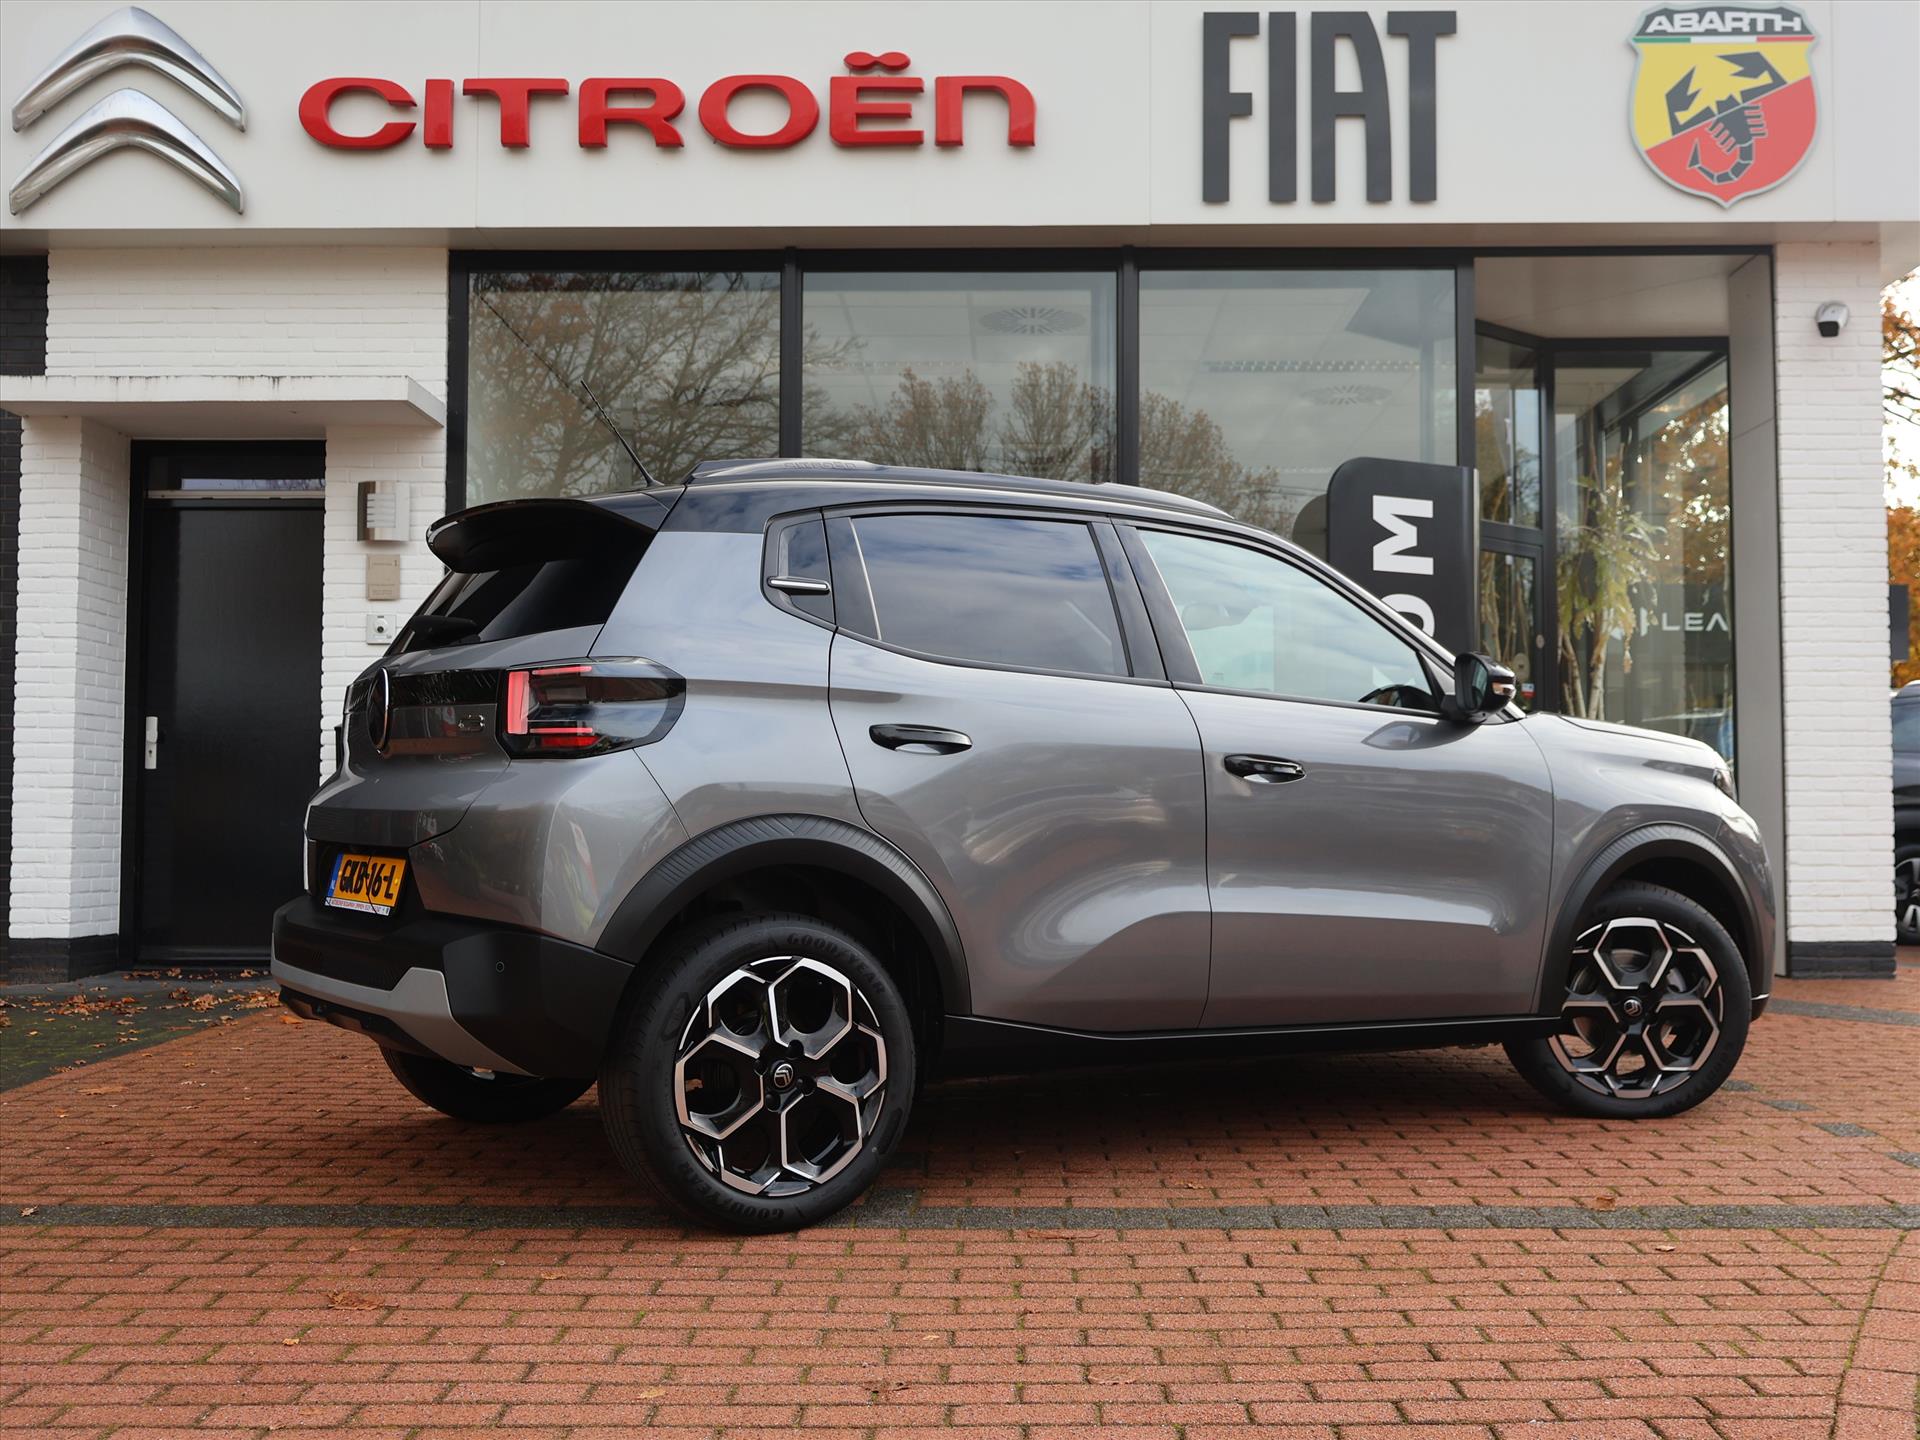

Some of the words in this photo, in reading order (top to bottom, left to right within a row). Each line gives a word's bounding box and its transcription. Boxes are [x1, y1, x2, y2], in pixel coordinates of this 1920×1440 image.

[1645, 11, 1801, 33] ABARTH
[298, 51, 1036, 150] CITROËN
[1202, 11, 1457, 204] FIAT
